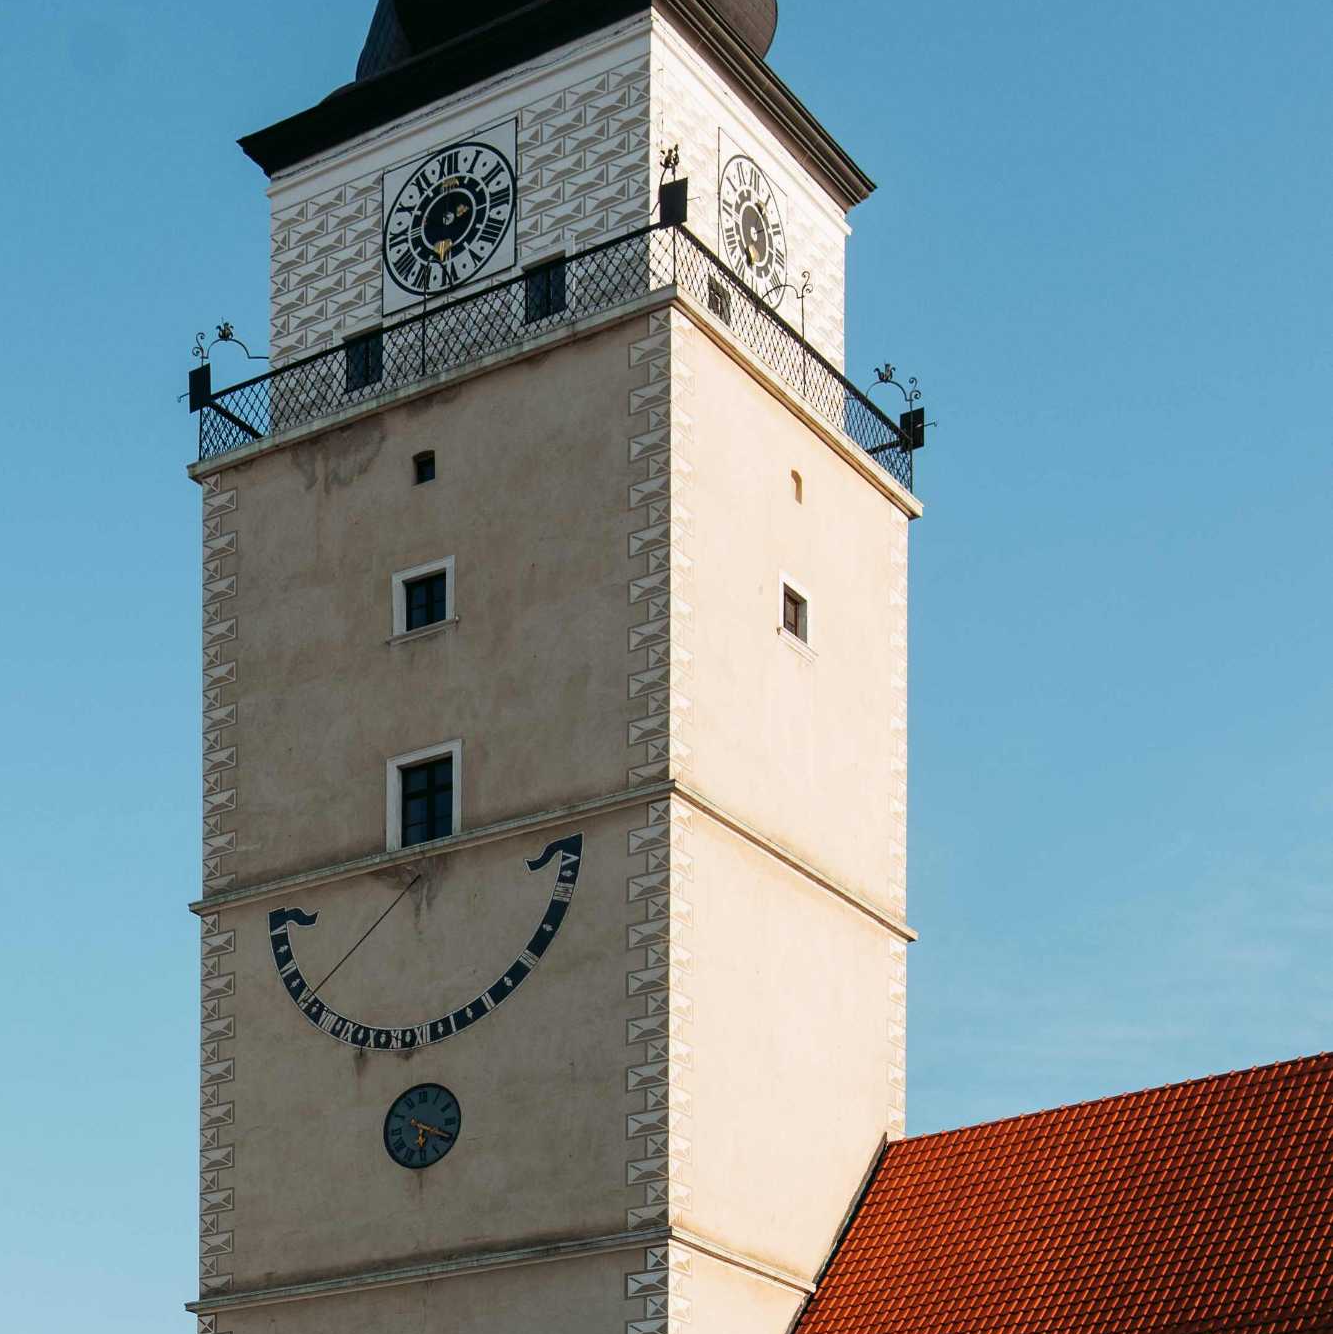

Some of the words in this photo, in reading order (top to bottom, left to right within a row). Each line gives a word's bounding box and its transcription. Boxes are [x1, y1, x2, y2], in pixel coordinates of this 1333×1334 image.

[436, 150, 461, 181] XII
[480, 161, 505, 188] II
[489, 184, 510, 209] III
[366, 1028, 378, 1048] X
[414, 1025, 431, 1046] XII
